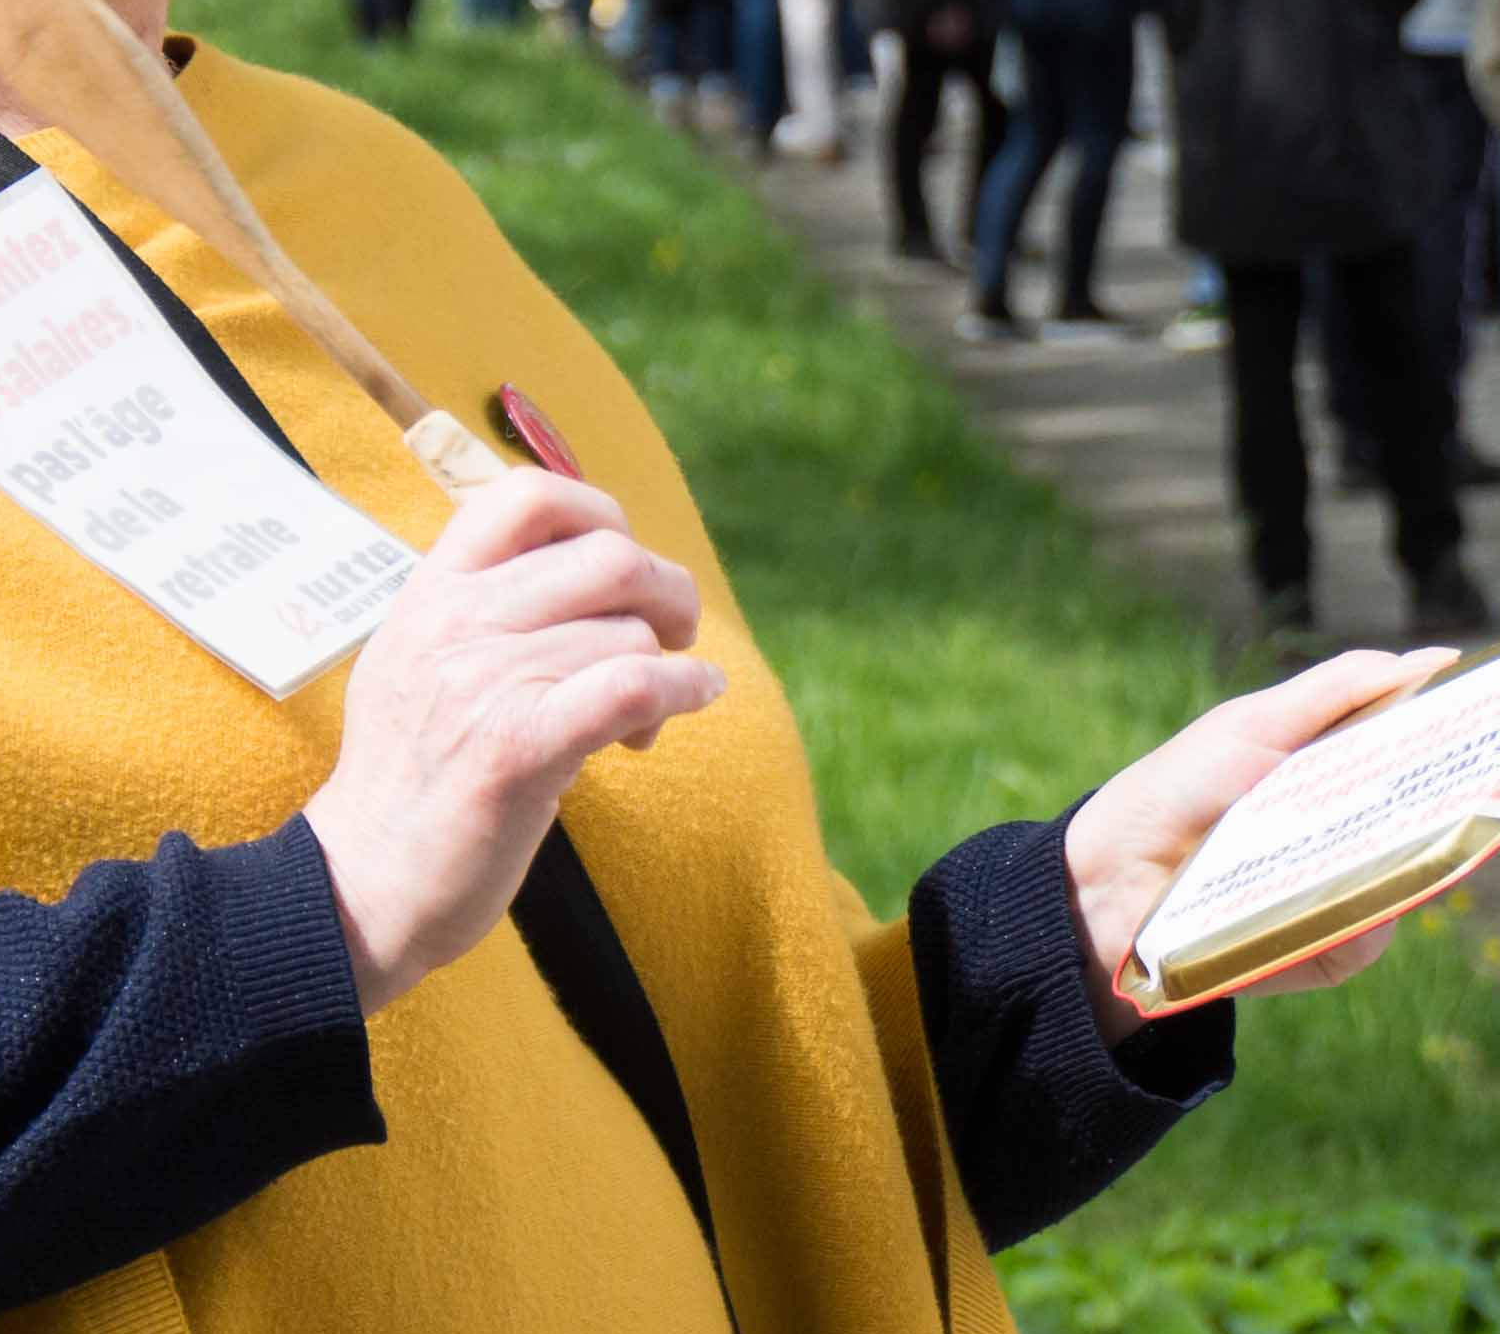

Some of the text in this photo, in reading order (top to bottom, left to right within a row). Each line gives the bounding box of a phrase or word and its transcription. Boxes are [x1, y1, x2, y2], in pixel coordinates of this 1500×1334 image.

[6, 432, 92, 506] pas
[79, 483, 188, 554] de la
[157, 512, 302, 611] retraite
[297, 539, 406, 610] lutte
[1324, 755, 1479, 836] mauvais
[1201, 836, 1311, 891] coups
